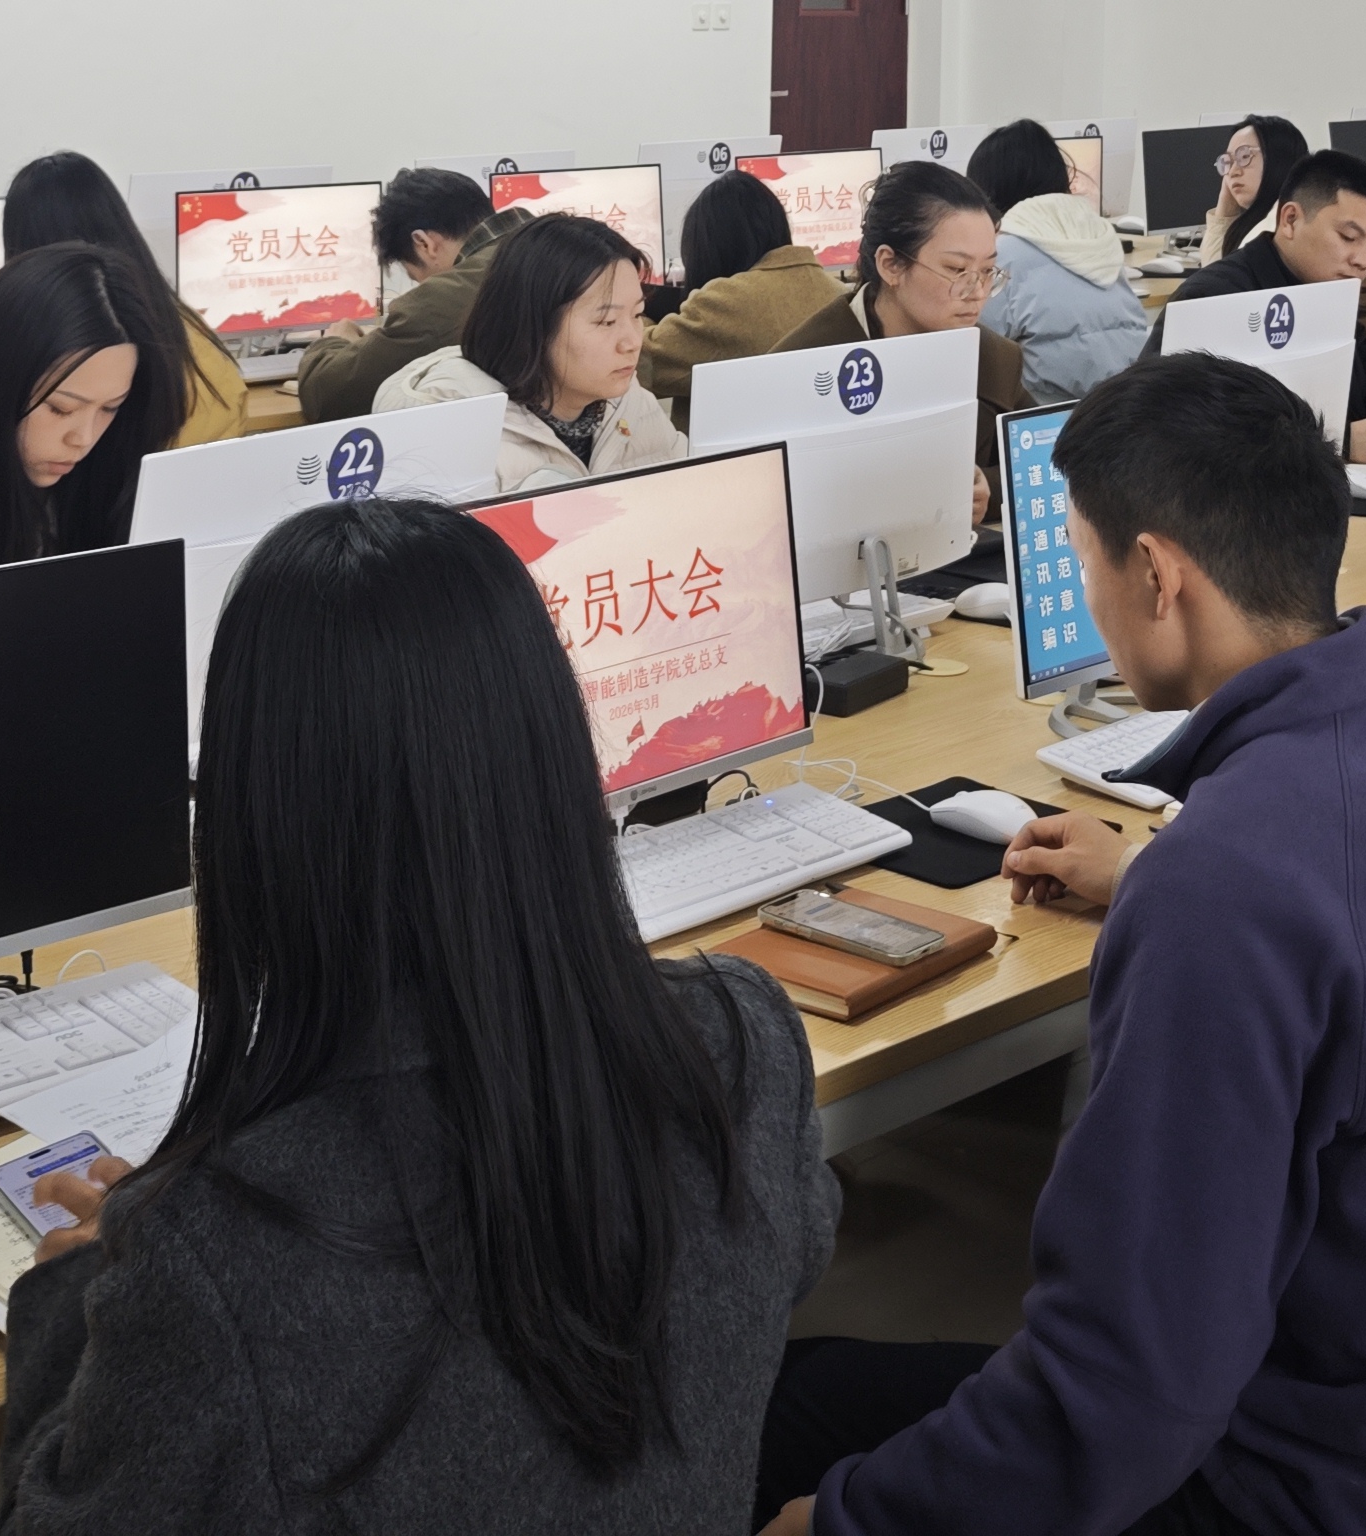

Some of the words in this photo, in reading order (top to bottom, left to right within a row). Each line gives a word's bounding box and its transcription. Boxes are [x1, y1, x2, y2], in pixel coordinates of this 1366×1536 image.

[713, 146, 728, 162] 06
[933, 134, 944, 148] 07
[227, 225, 340, 264] 党员大会
[1270, 302, 1290, 327] 24
[1270, 331, 1288, 344] 2220
[845, 356, 875, 390] 23
[848, 391, 875, 410] 2220
[338, 438, 374, 478] 22
[1027, 463, 1058, 652] 谨防通讯诈骗
[609, 694, 660, 721] 2026年3月
